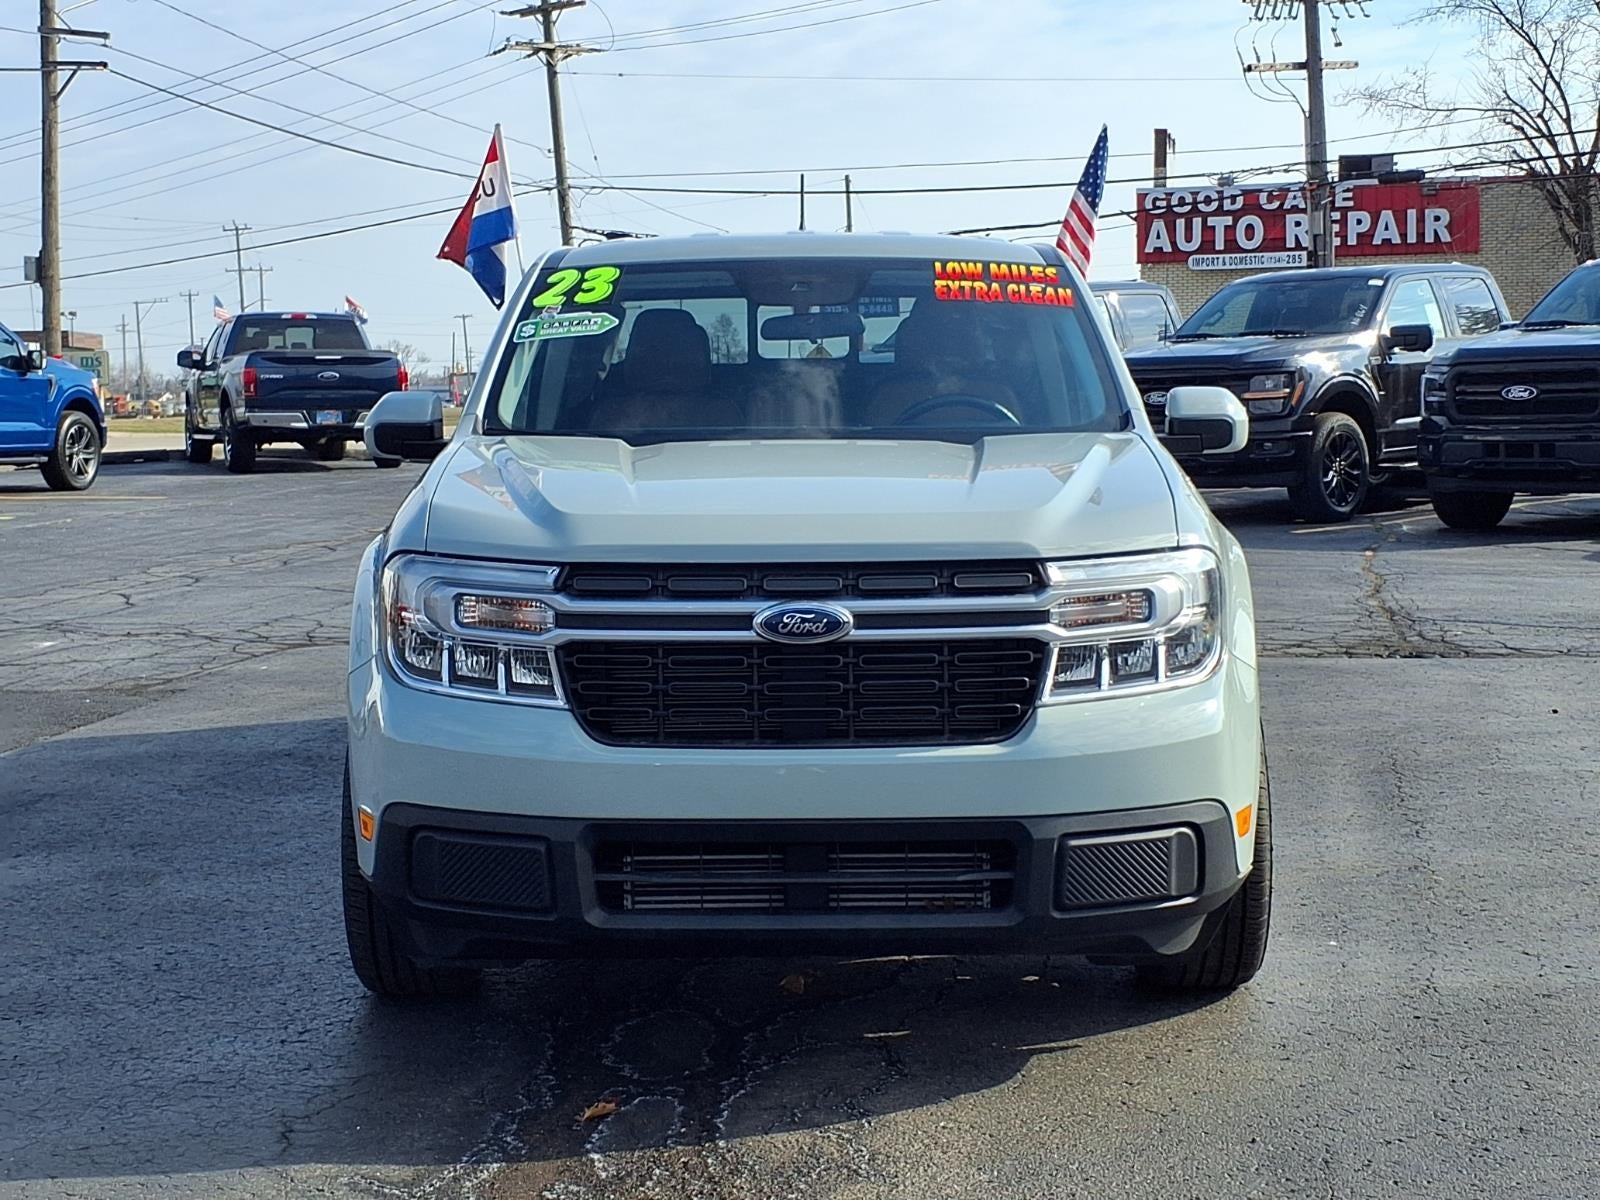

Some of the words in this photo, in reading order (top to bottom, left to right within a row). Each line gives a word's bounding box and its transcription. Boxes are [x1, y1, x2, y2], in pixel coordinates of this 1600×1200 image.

[1144, 186, 1245, 214] GOOD
[1258, 184, 1355, 211] CAE
[1144, 214, 1265, 253] AUTO
[934, 261, 983, 280] LOW
[989, 262, 1060, 284] MILES
[1192, 256, 1220, 267] IMPORT
[1221, 255, 1227, 266] &
[1229, 254, 1265, 266] DOMESTIC
[533, 266, 621, 308] 23
[934, 279, 1004, 303] EXTRA
[1006, 283, 1075, 307] CLEAN
[778, 612, 828, 633] Ford
